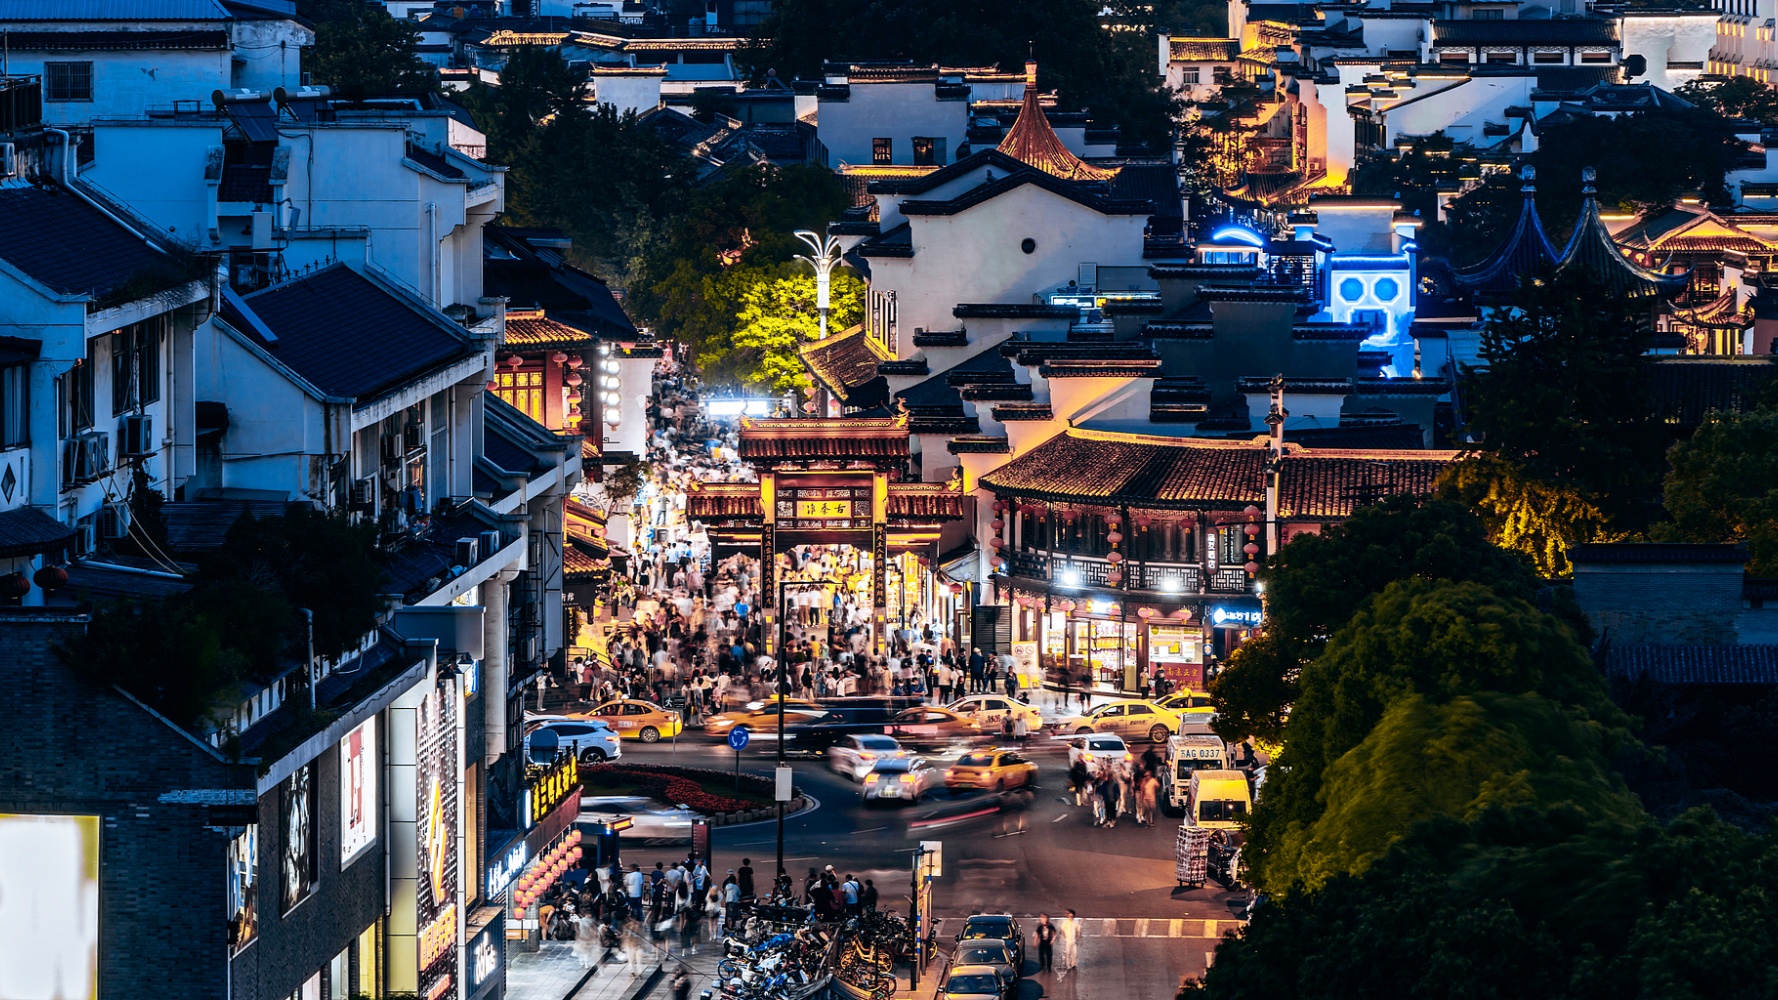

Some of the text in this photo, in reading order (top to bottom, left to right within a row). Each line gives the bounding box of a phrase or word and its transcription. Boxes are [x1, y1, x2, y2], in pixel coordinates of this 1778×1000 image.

[807, 502, 846, 515] 古秦淮
[1200, 749, 1220, 758] 0337
